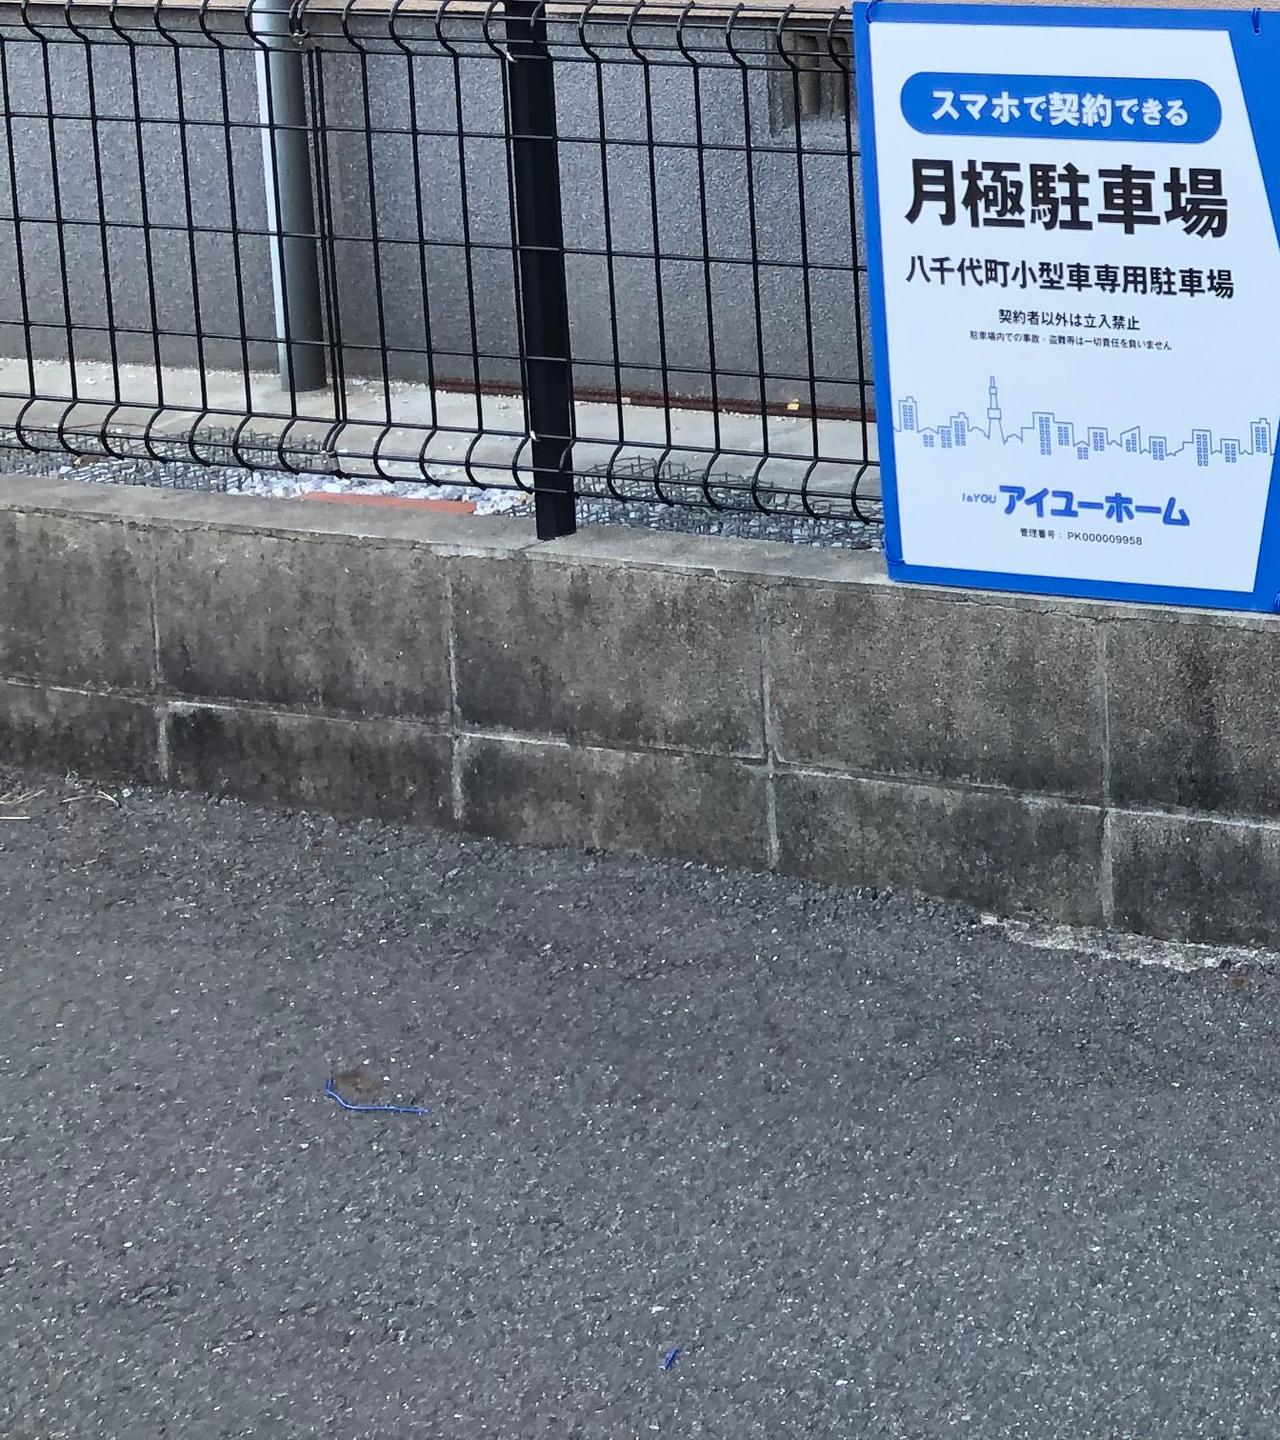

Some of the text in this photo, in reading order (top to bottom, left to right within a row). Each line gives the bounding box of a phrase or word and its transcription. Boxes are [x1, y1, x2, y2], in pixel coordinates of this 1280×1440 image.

[931, 89, 1189, 127] スマホで契約できる
[904, 158, 1229, 239] 月極駐車場
[906, 255, 1235, 299] 八千代町小型車専用駐車場
[998, 309, 1141, 331] 契約者以外は立入禁止
[999, 485, 1190, 527] アイユーホーム
